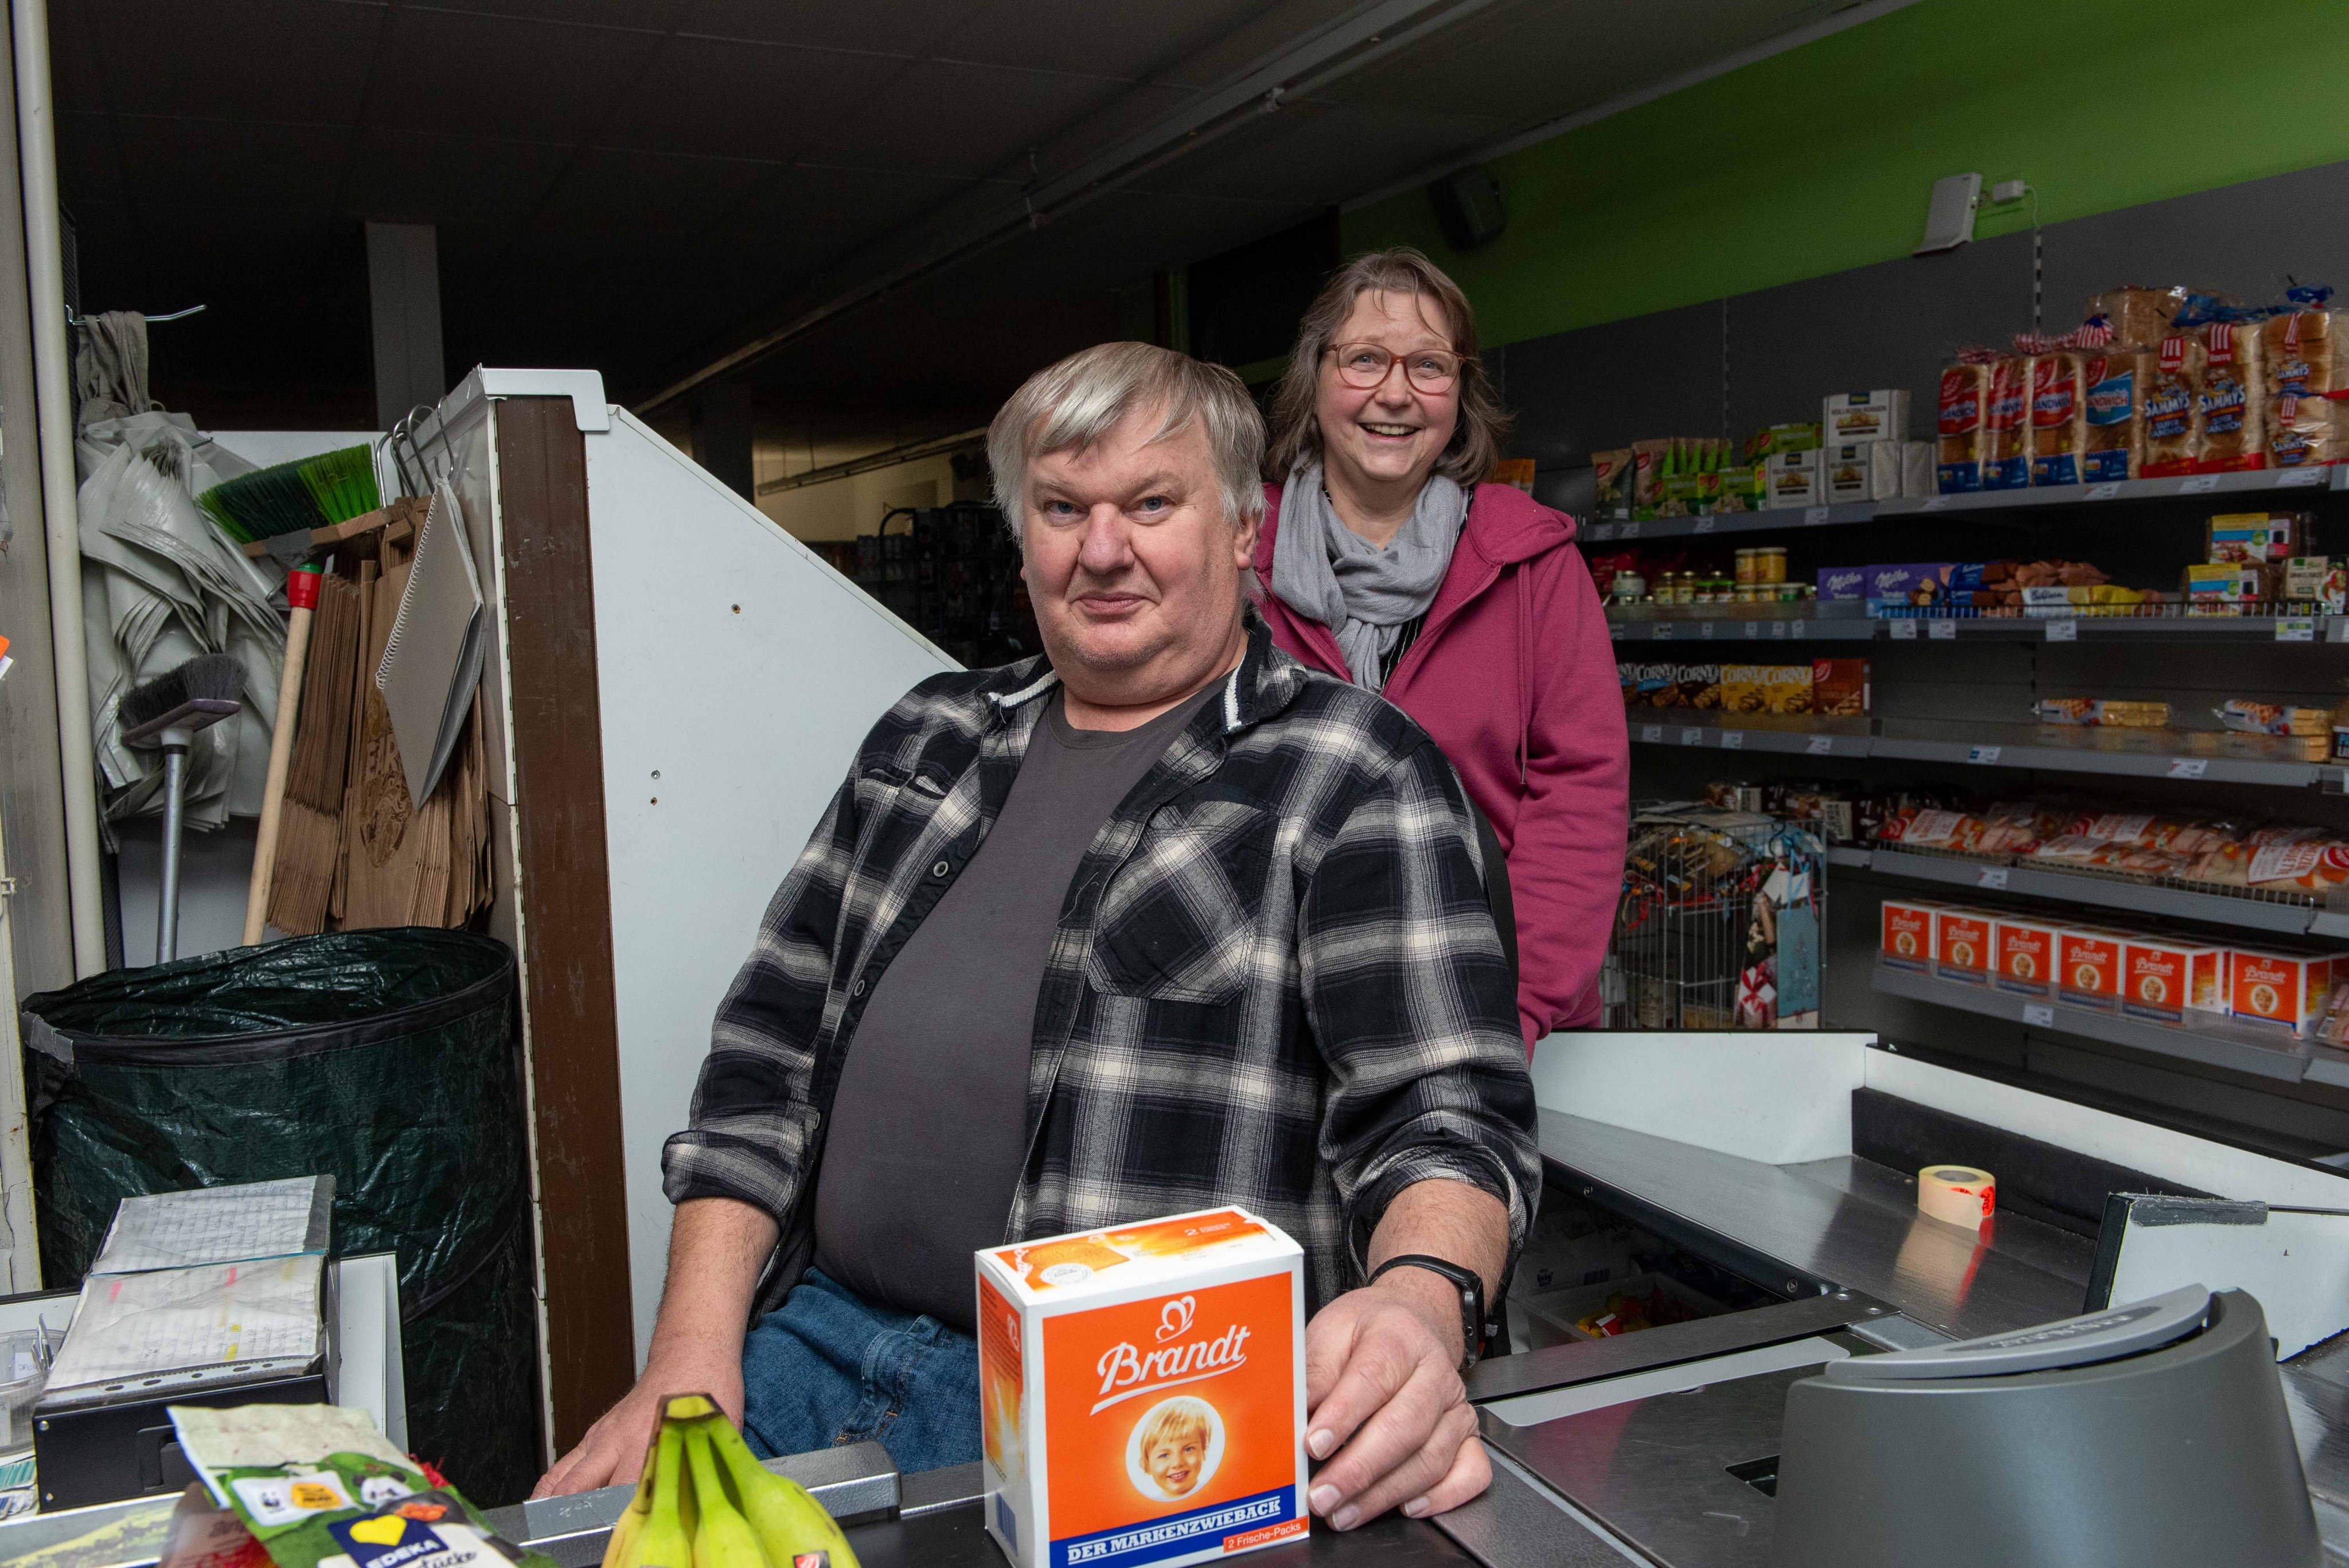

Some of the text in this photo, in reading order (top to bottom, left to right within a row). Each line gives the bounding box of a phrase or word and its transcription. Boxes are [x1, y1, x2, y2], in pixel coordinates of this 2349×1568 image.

[2146, 390, 2191, 418] SAMMY'S
[2199, 385, 2246, 415] SAMMY'S
[1875, 568, 1909, 589] Milka
[1637, 663, 1676, 682] CORNY
[1677, 663, 1719, 684] CORNY
[1720, 665, 1765, 685] CORNY
[1765, 666, 1813, 686] CORNY
[1891, 915, 1922, 931] Brandt
[1948, 925, 1980, 941] Brandt
[2008, 935, 2042, 953] Brandt
[2070, 945, 2108, 963] Brandt
[2136, 957, 2175, 975] Brandt
[2245, 965, 2286, 982] Brandt
[1097, 1324, 1251, 1395] Brandt
[1068, 1498, 1281, 1562] DER MARKENZWIEBACK
[1228, 1522, 1301, 1550] 2 Frische-Packs
[365, 1539, 440, 1568] EDEKA
